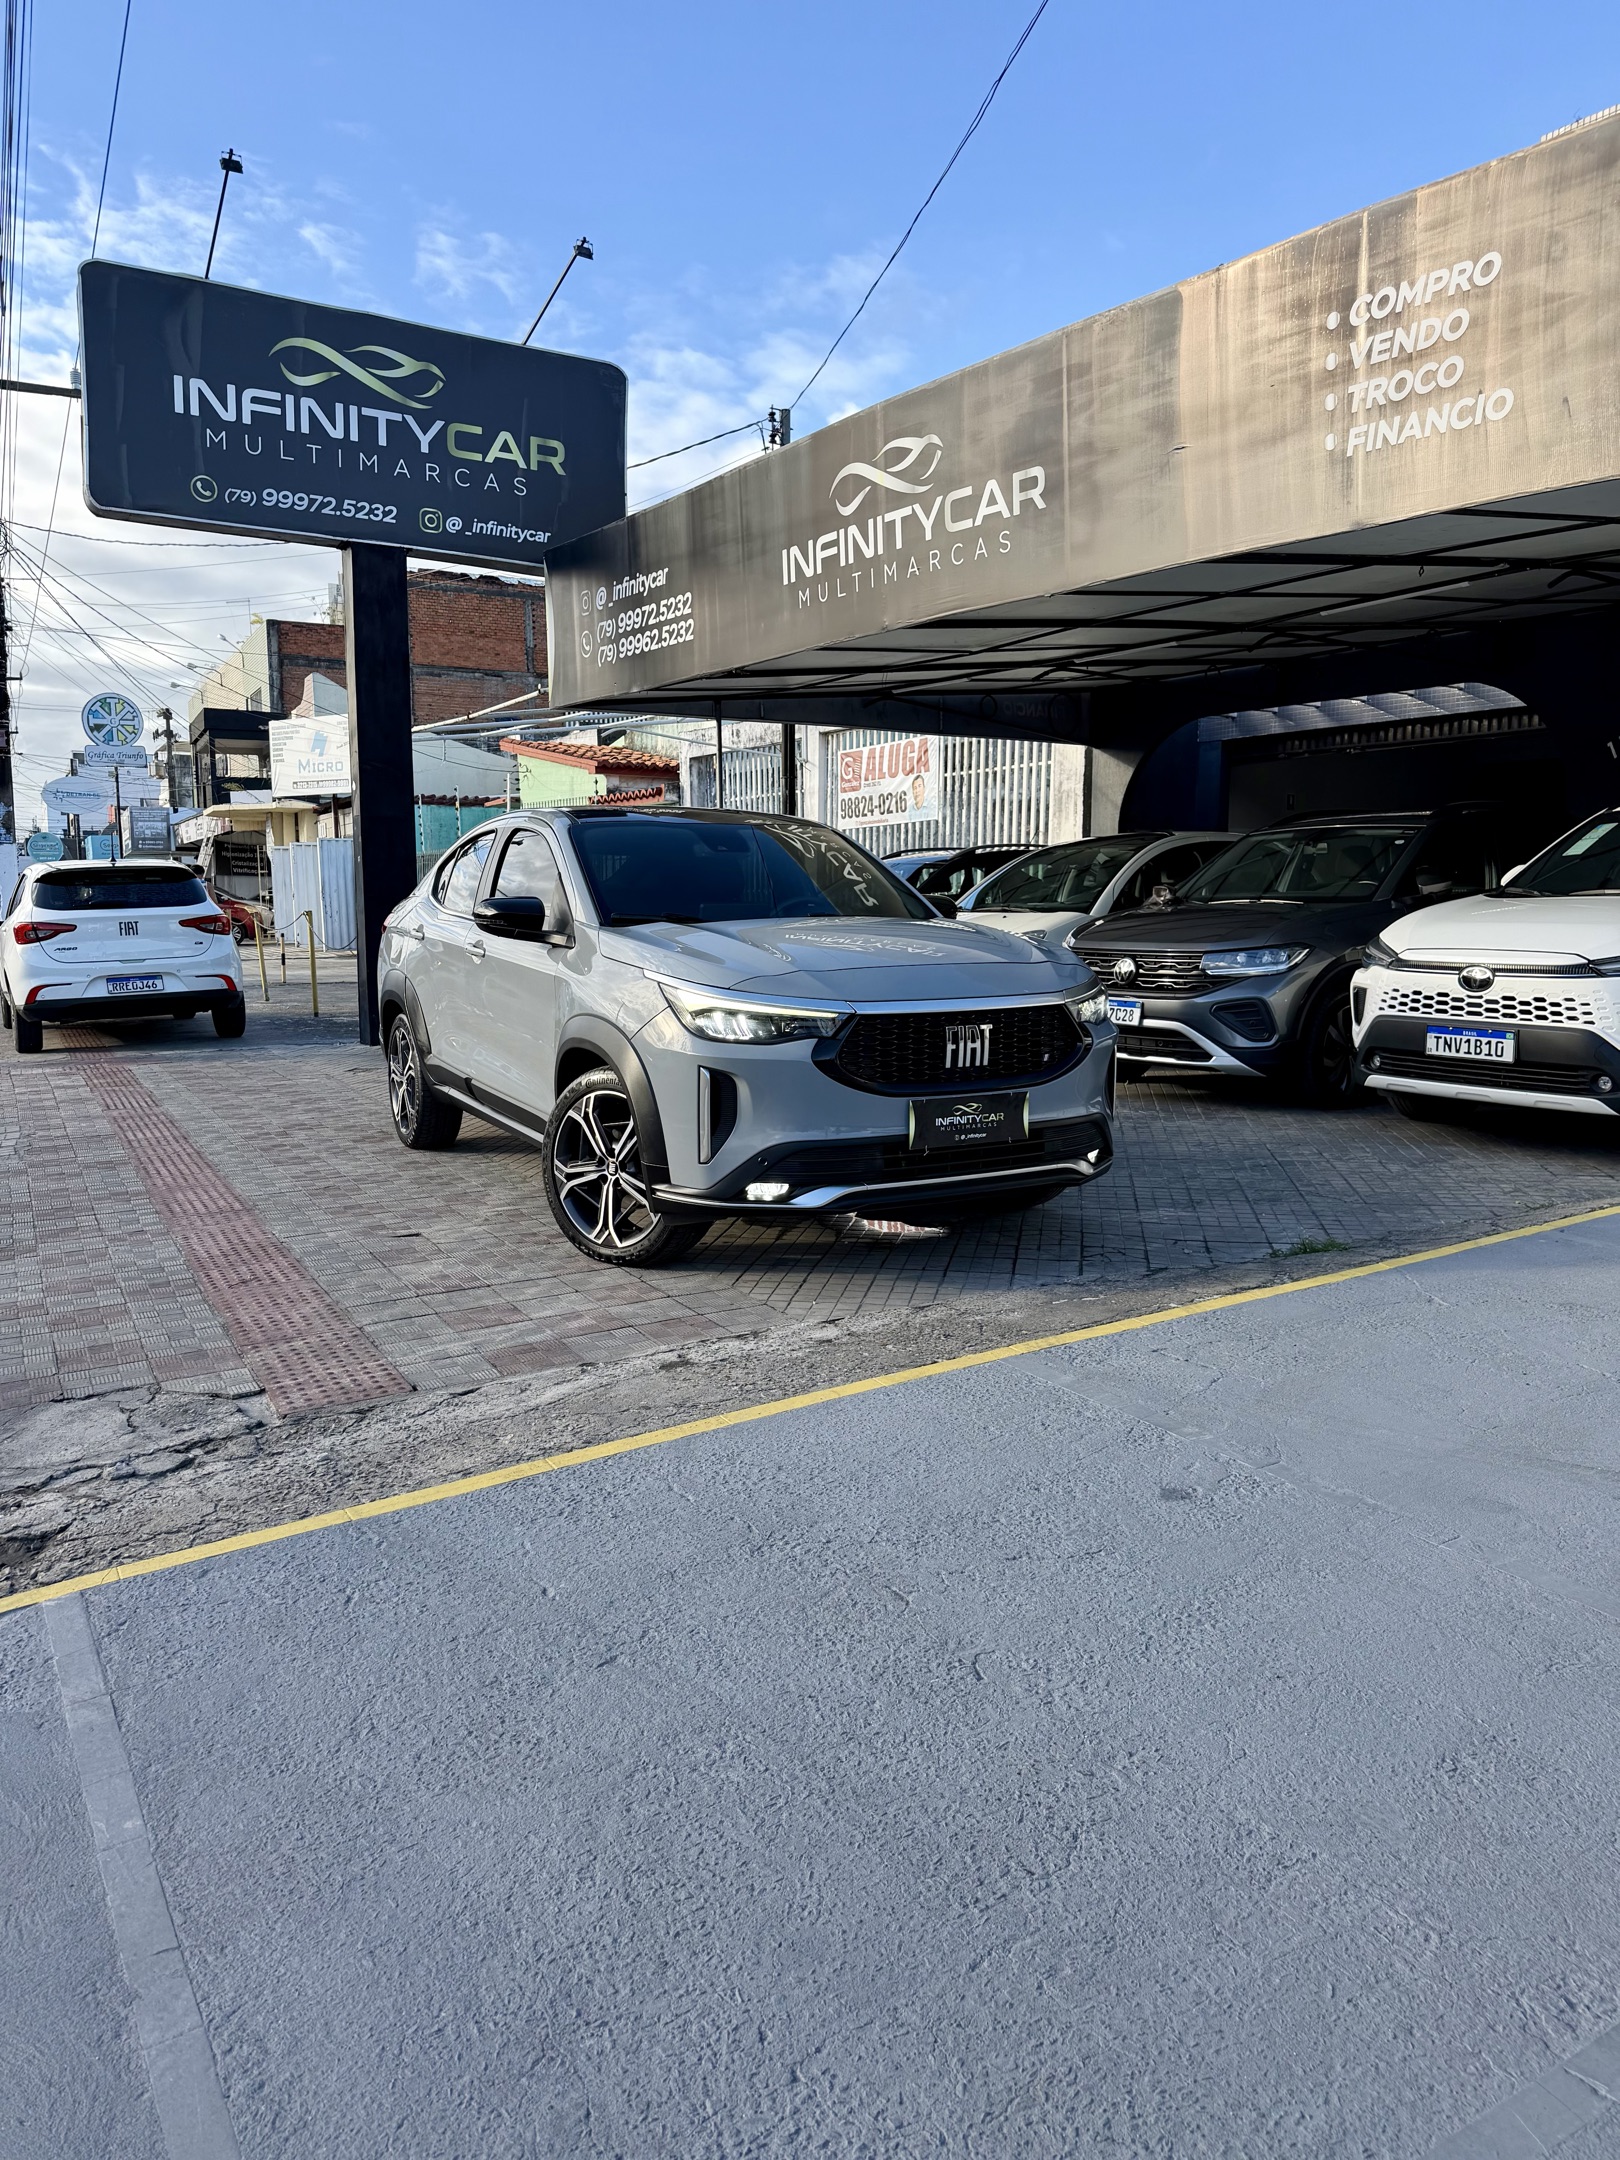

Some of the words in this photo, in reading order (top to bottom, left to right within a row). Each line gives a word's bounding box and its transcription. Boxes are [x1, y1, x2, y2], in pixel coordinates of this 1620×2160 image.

[1349, 251, 1502, 327] COMPRO
[1349, 308, 1470, 370] VENDO
[1347, 355, 1464, 413] TROCO
[172, 374, 567, 476] INFINITYCAR
[1346, 387, 1515, 457] FINANCIO
[206, 427, 528, 497] MULTIMARCAS
[224, 487, 257, 508] (79)
[261, 488, 398, 525] 99972.5232
[782, 465, 1047, 585] INFINITYCAR
[799, 530, 1012, 609] MULTIMARCAS
[597, 617, 616, 641] (79)
[618, 592, 693, 635] 99972.5232
[597, 644, 617, 667] (79)
[618, 619, 695, 659] 99962.5232
[116, 751, 144, 762] Triunfo
[842, 757, 854, 780] G
[863, 737, 931, 782] ALUGA
[840, 790, 908, 820] 98824-0216
[231, 860, 264, 868] Cristalizaço
[118, 921, 139, 936] FIAT
[945, 1024, 993, 1068] FIAT
[1433, 1035, 1504, 1058] TNV1B10
[935, 1112, 1005, 1127] INFINITYCAR
[940, 1122, 998, 1132] MULTIMARCAS
